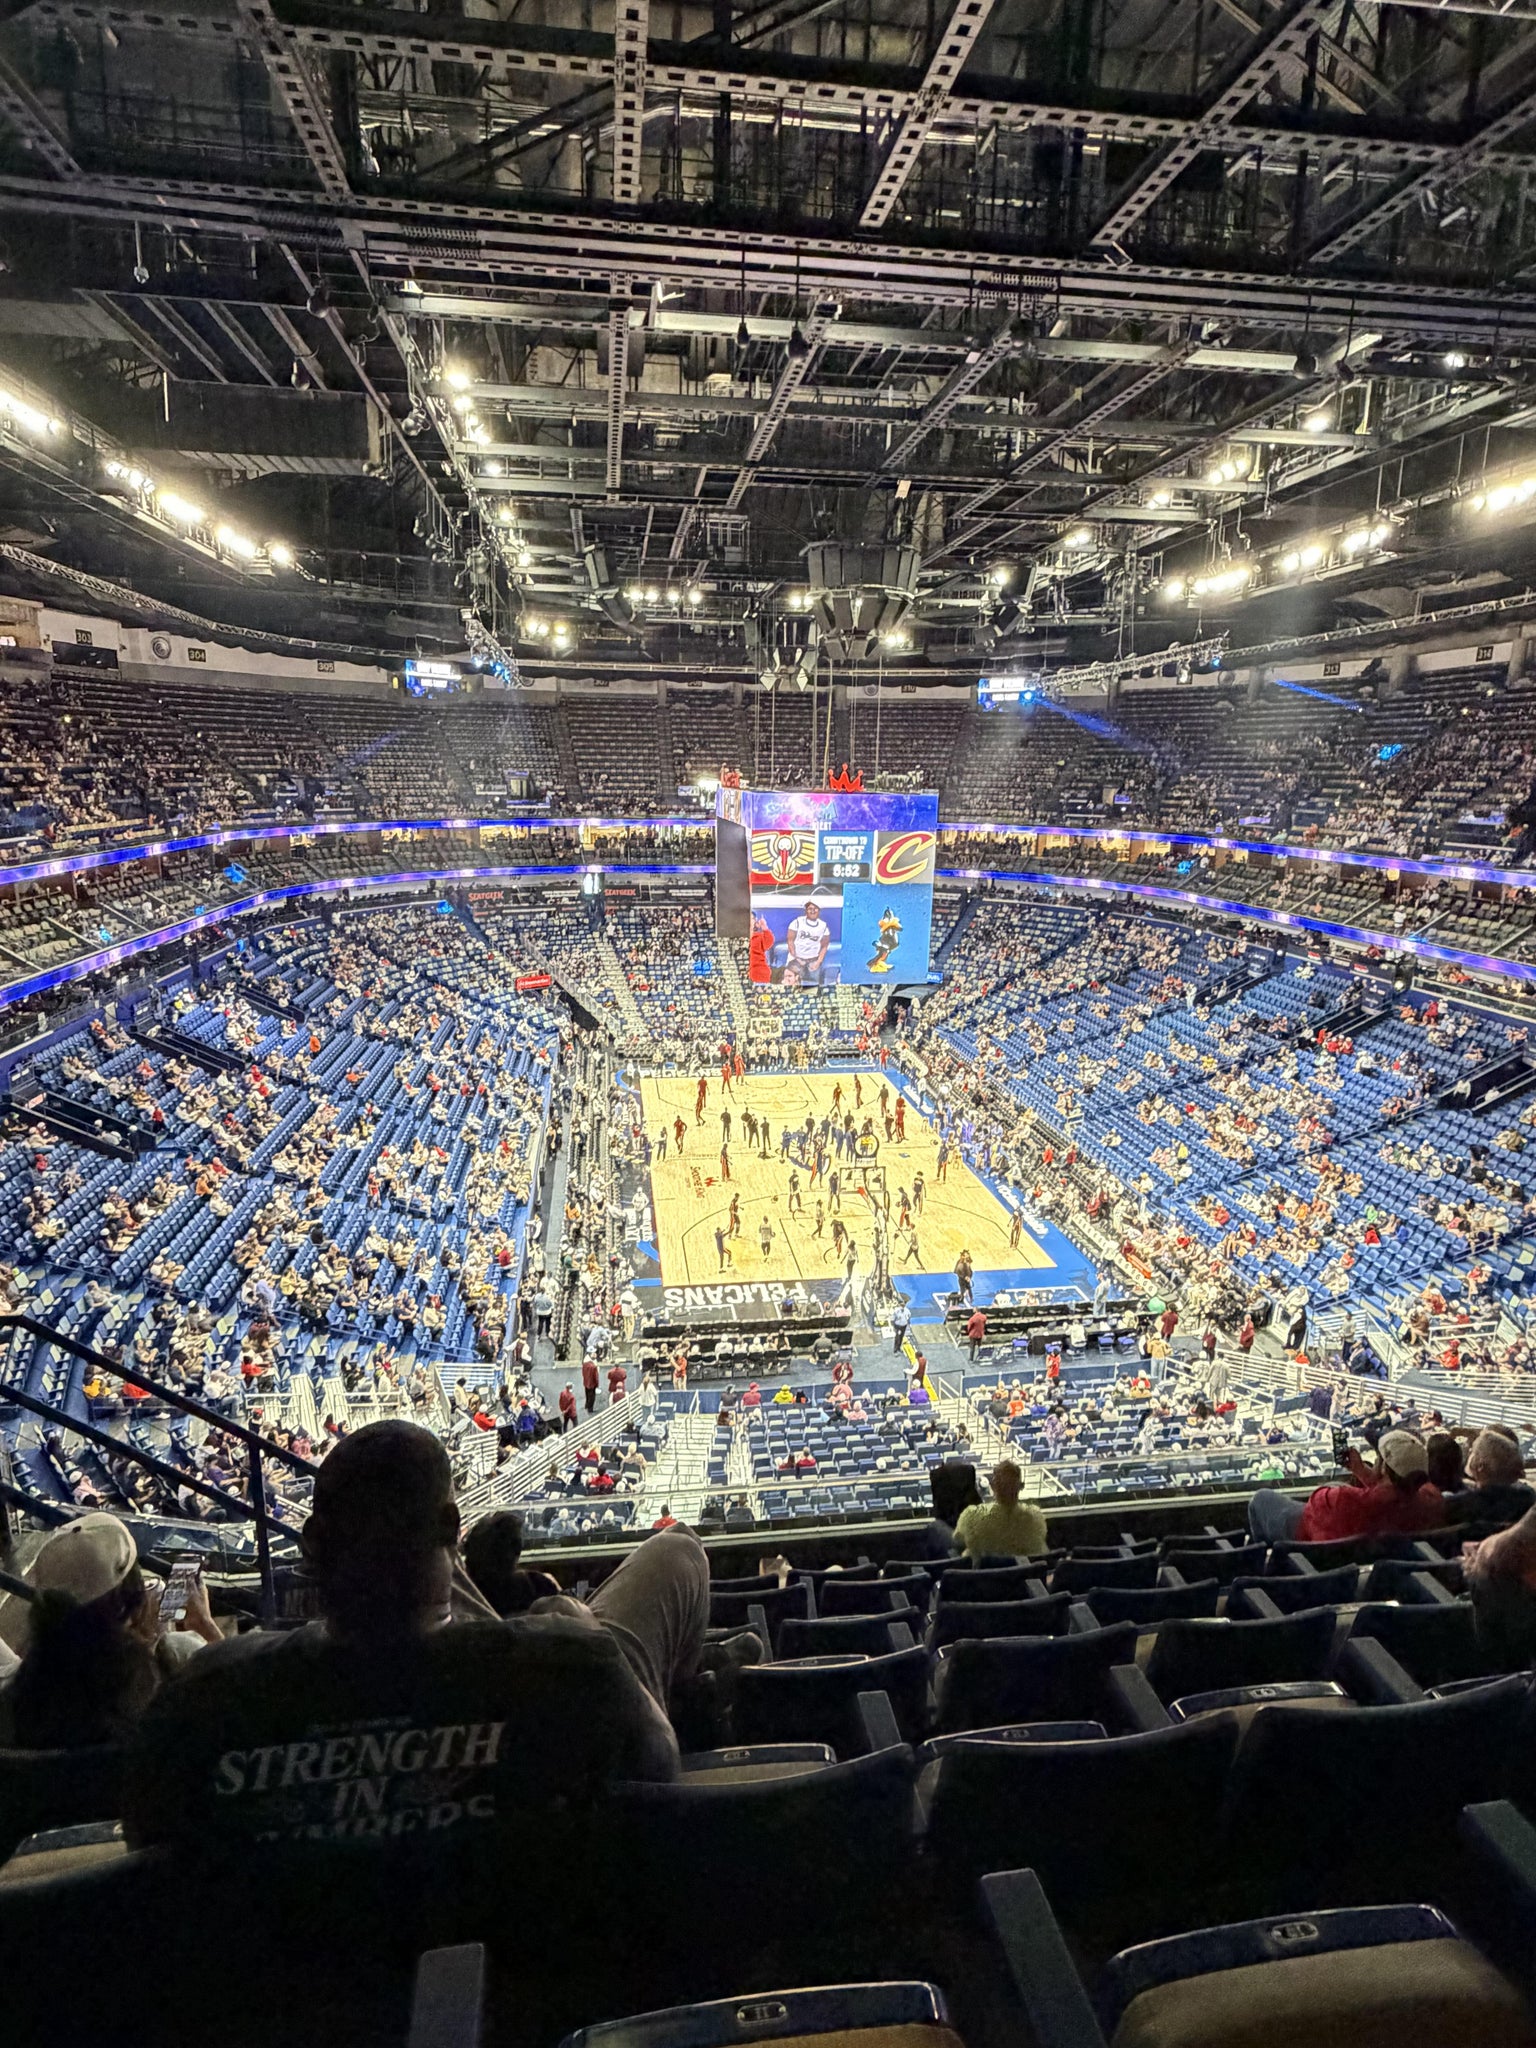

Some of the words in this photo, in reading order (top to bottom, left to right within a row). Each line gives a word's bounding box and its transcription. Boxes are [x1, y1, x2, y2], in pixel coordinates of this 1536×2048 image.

[76, 631, 92, 644] 303
[188, 649, 206, 661] 304
[318, 661, 335, 672] 305
[824, 845, 866, 861] TIP-OFF
[468, 890, 505, 902] SEATGEEK
[663, 1281, 809, 1308] PELICANS
[214, 1721, 507, 1796] STRENGTH
[333, 1775, 390, 1819] IN
